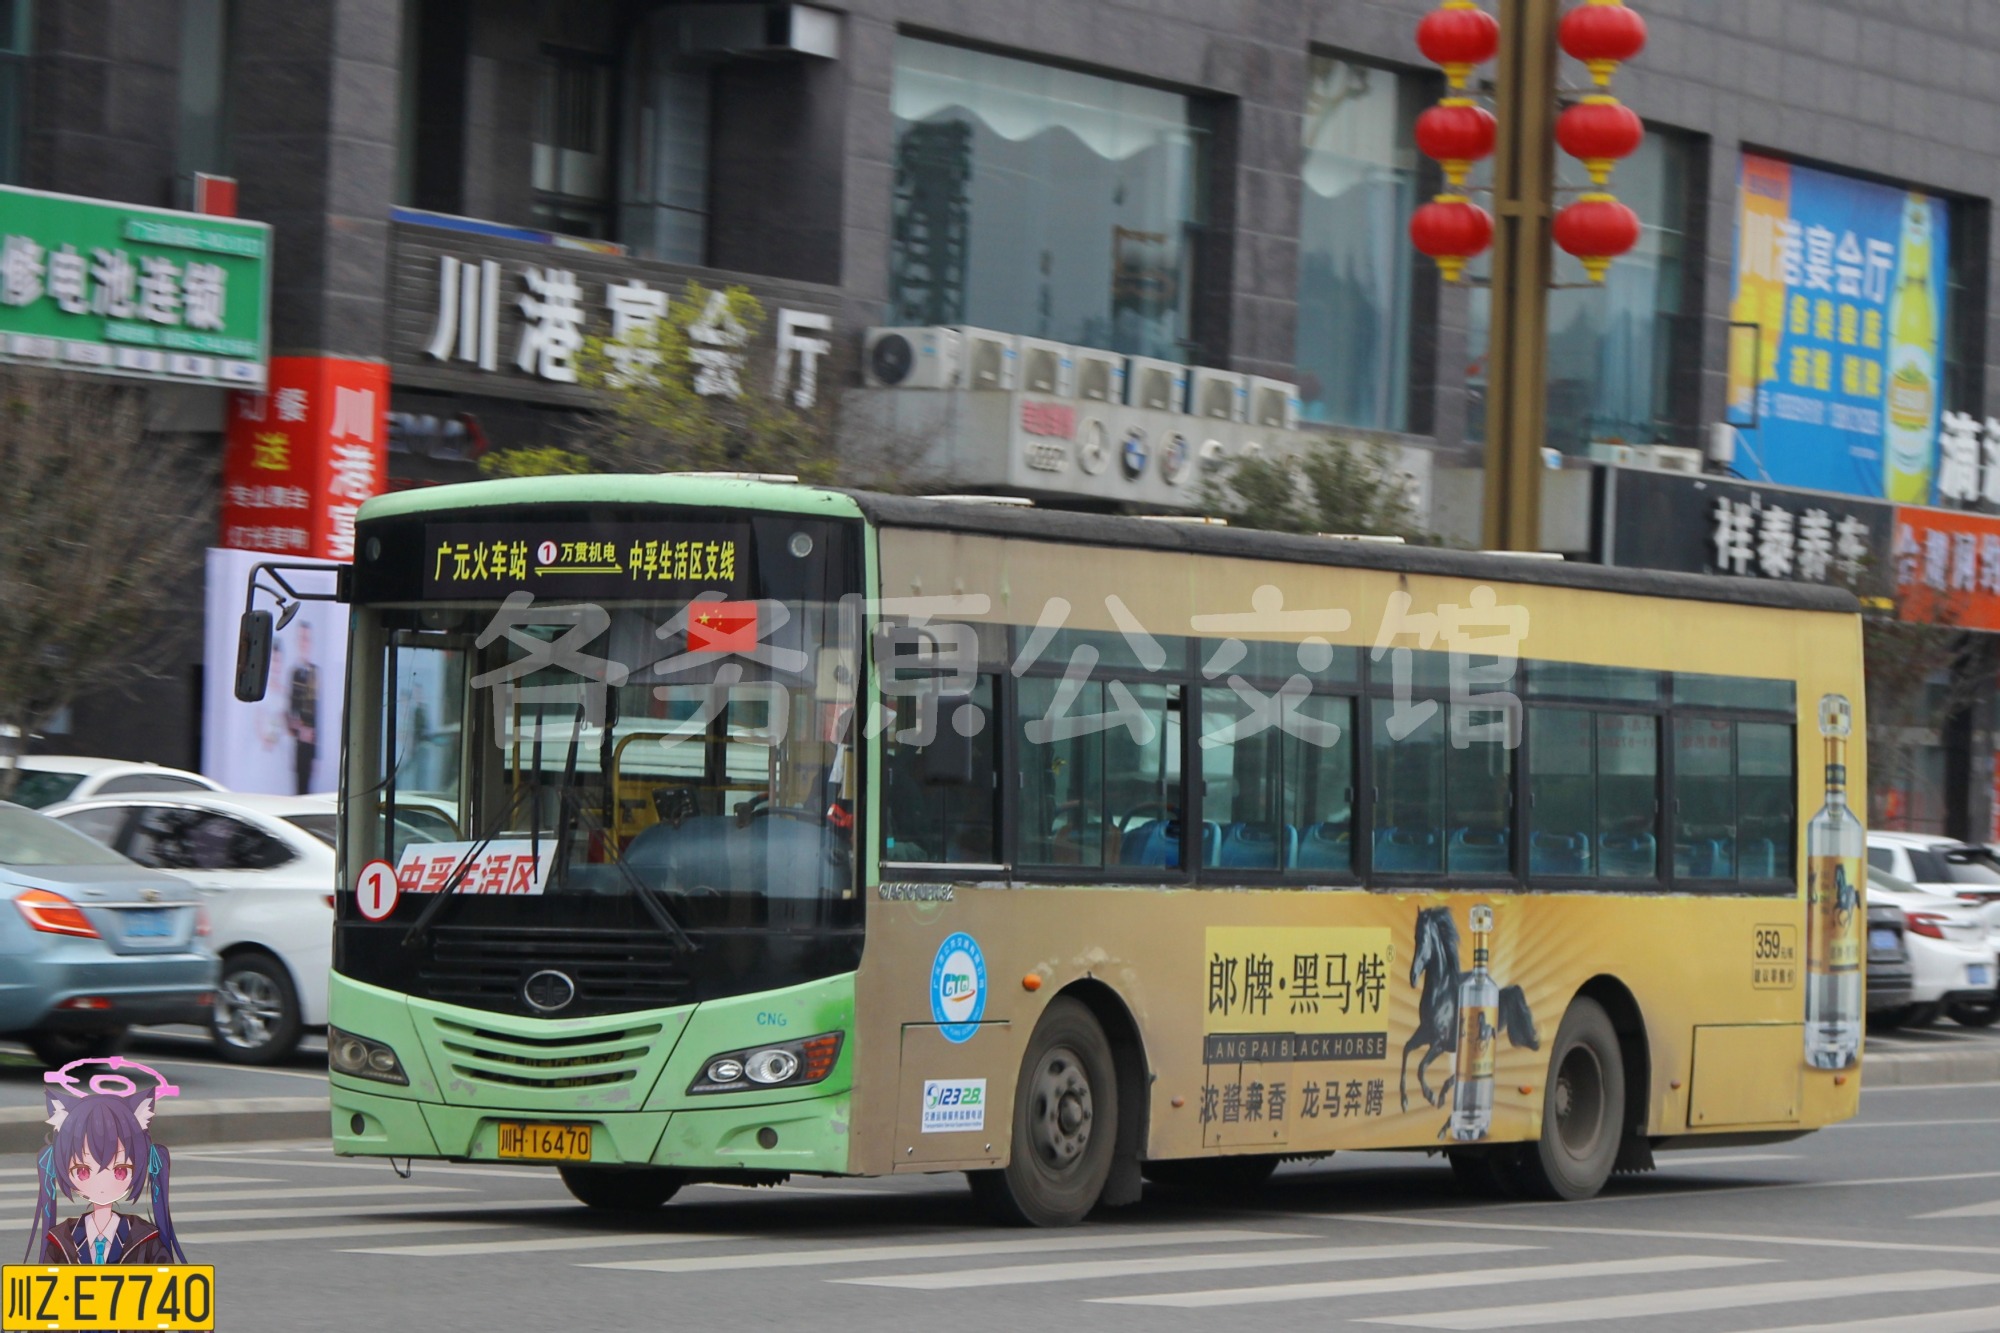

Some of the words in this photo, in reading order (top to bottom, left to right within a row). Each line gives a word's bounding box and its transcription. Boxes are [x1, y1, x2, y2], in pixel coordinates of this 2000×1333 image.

[434, 541, 528, 581] 广元火车站
[560, 542, 617, 563] 万贯机电
[628, 540, 735, 582] 中孚生活区支线
[398, 854, 541, 894] 中孚生活区
[1755, 930, 1780, 959] 359
[1208, 952, 1386, 1017] 郎牌·黑马特
[757, 1012, 787, 1027] CNG
[1335, 1037, 1384, 1056] HORSE
[938, 1087, 982, 1106] 12328
[1199, 1081, 1287, 1124] 浓酱兼香
[1301, 1078, 1385, 1119] 龙马奔腾
[501, 1128, 589, 1156] 川H·16470
